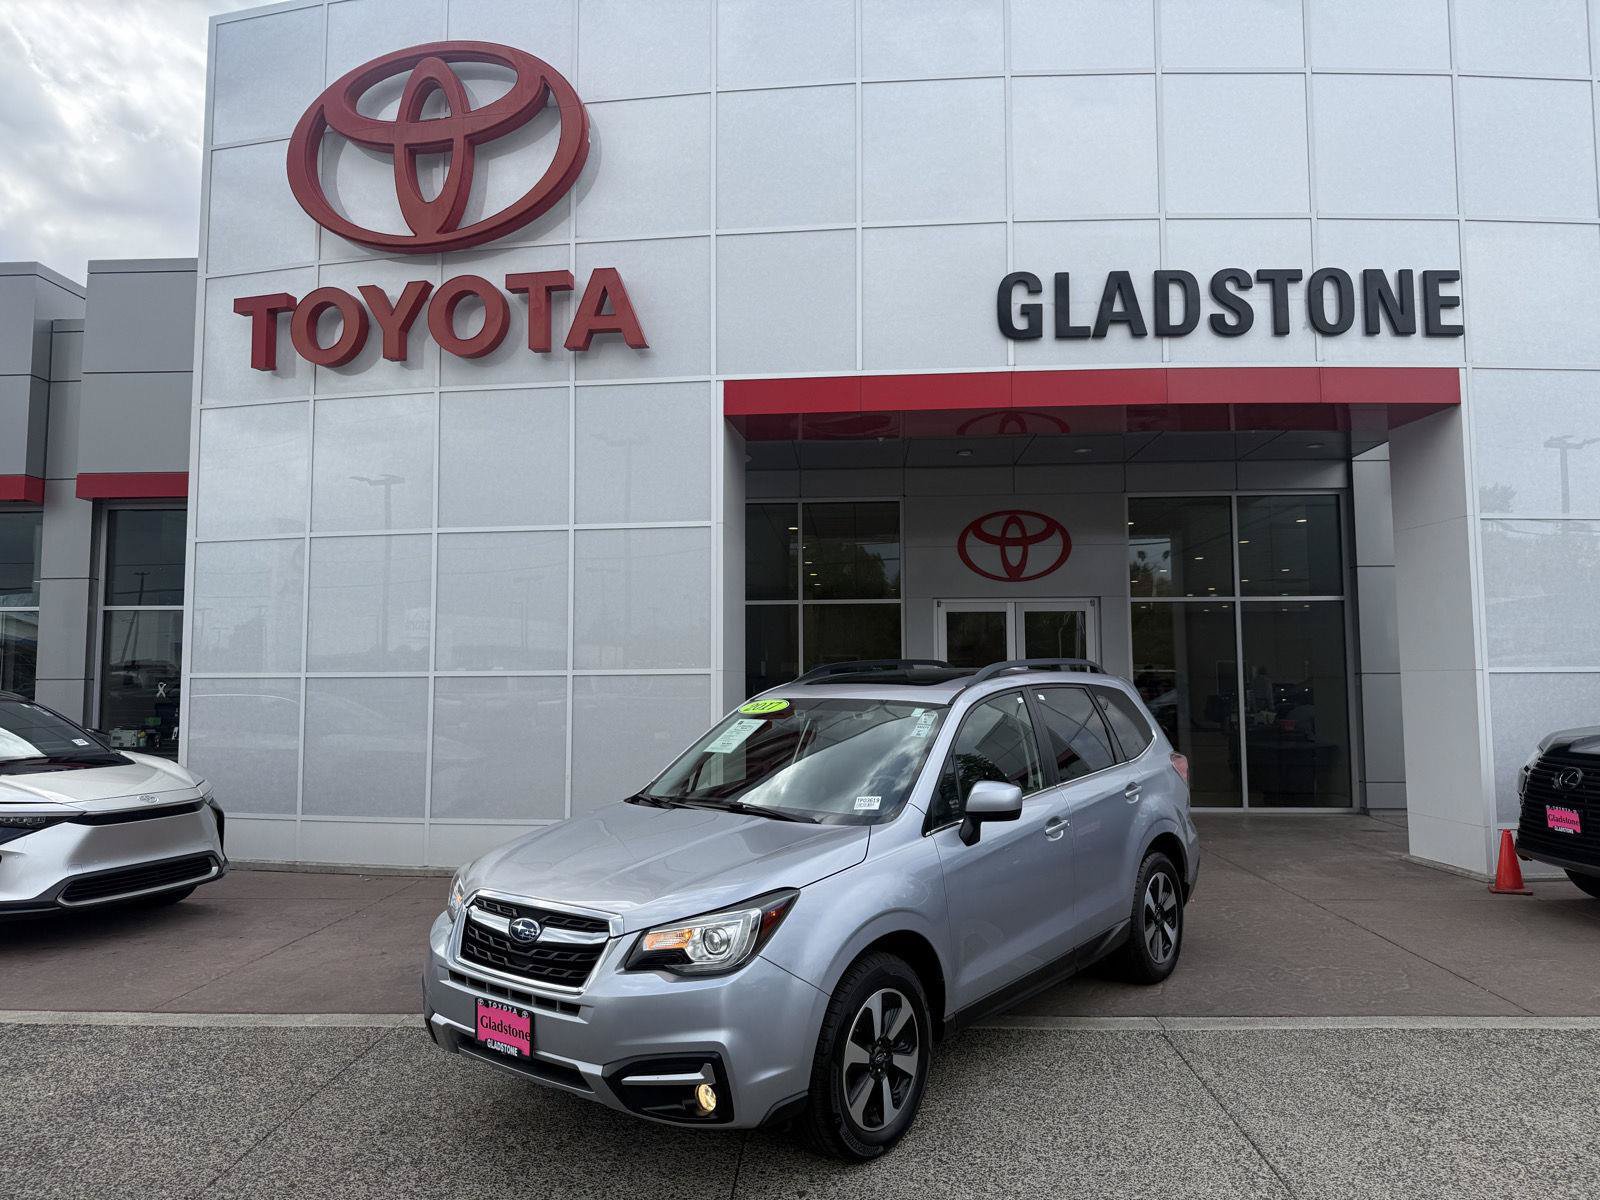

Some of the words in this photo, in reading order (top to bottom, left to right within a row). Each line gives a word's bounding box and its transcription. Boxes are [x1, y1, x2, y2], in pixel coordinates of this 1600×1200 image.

[997, 267, 1464, 340] GLADSTONE
[233, 267, 650, 371] TOYOTA
[488, 1001, 518, 1015] TOYOTA
[480, 1015, 531, 1042] Gladstone
[487, 1039, 518, 1057] GLADSTONE
